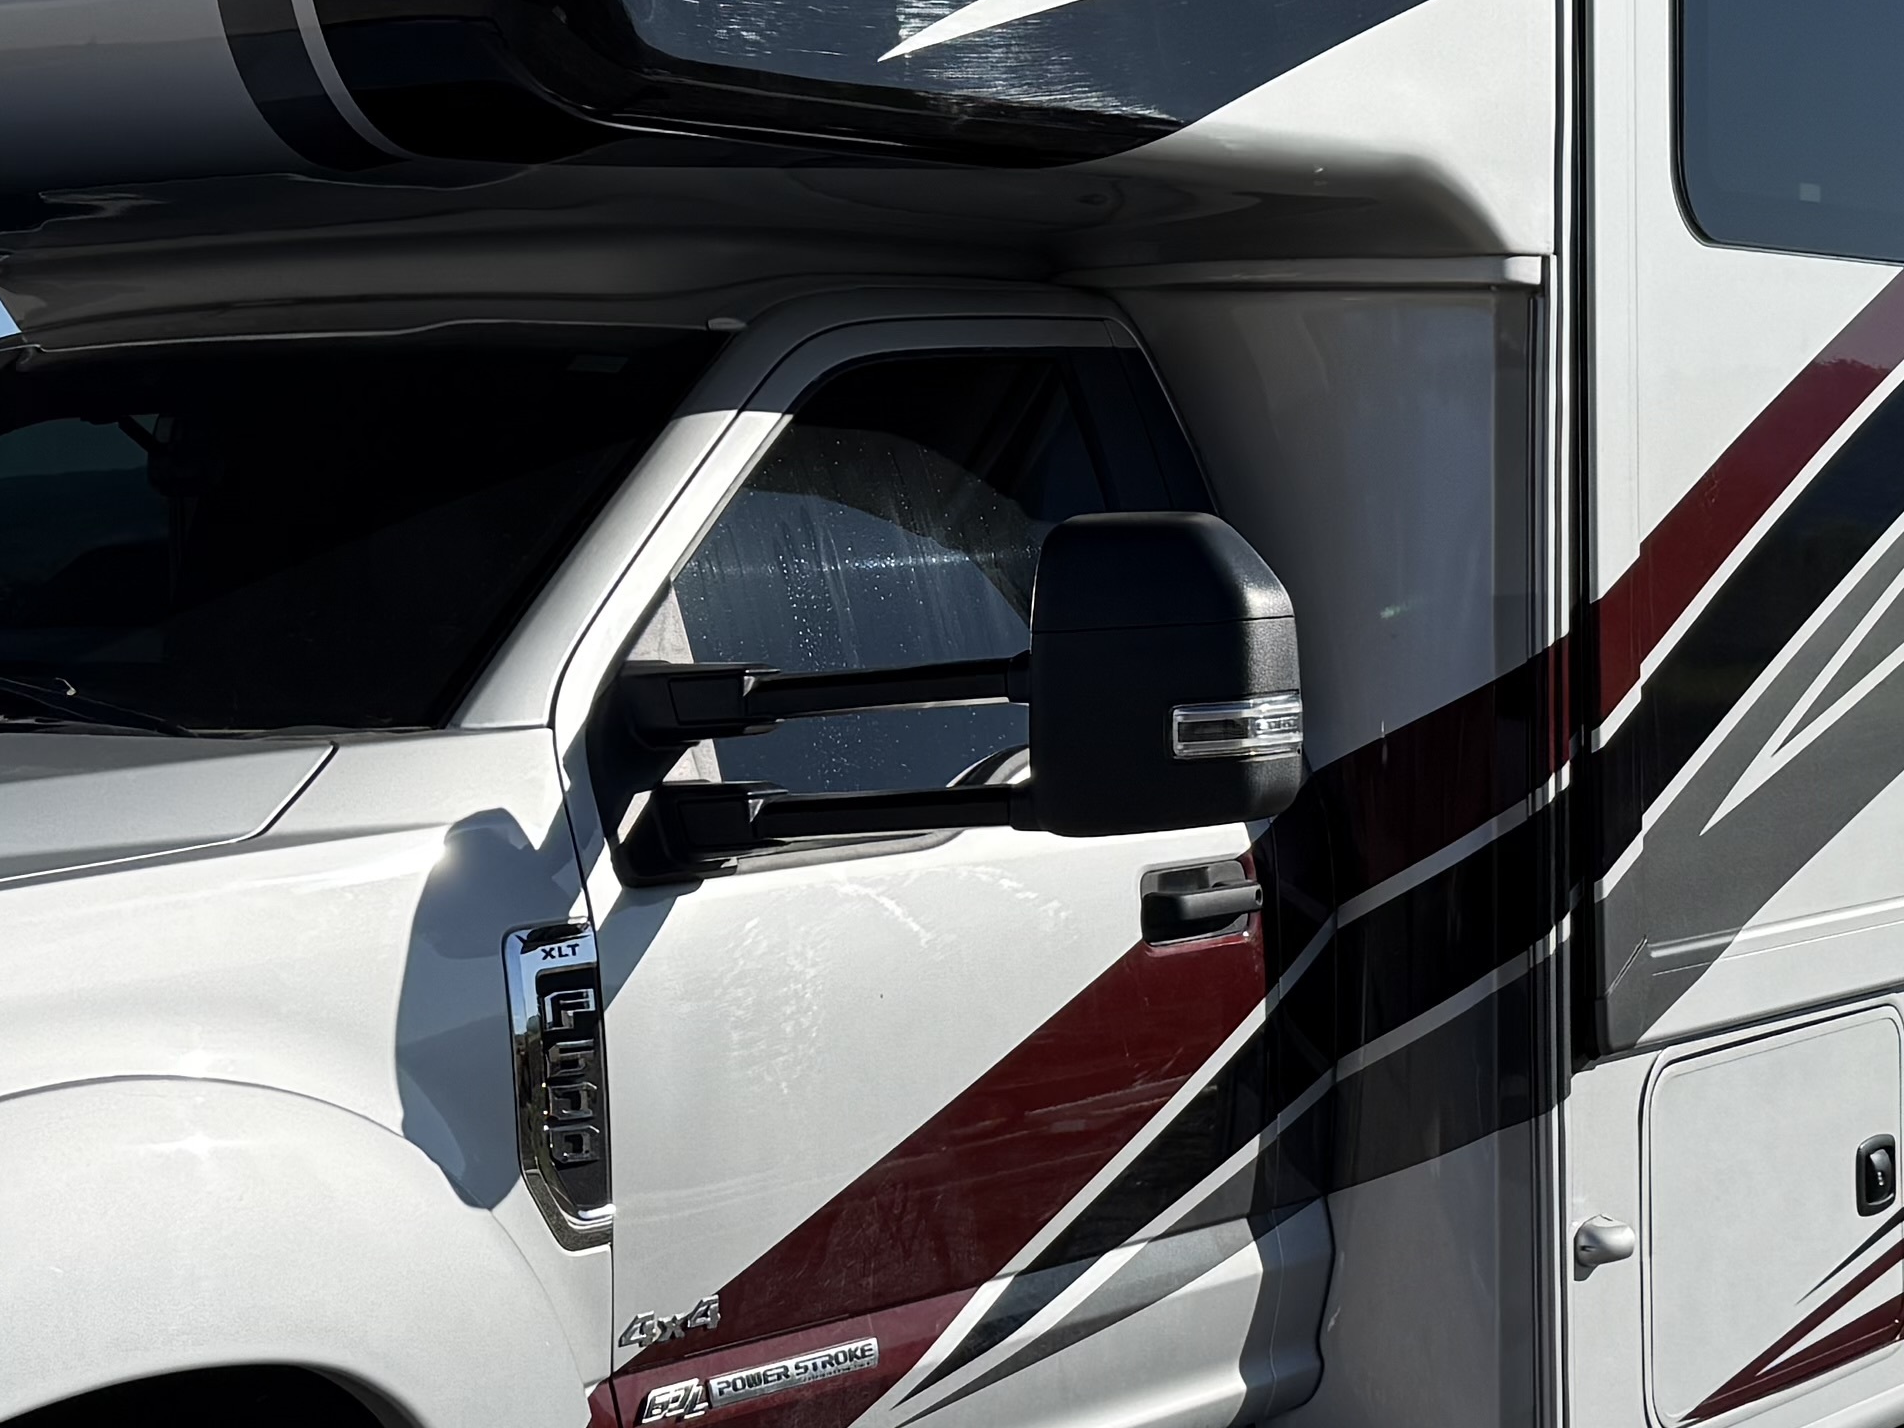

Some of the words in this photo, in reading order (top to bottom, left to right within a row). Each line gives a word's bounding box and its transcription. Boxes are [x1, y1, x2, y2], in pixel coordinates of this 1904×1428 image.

[541, 943, 580, 961] XLT
[716, 1364, 791, 1398] POWER
[794, 1342, 875, 1378] STROKE
